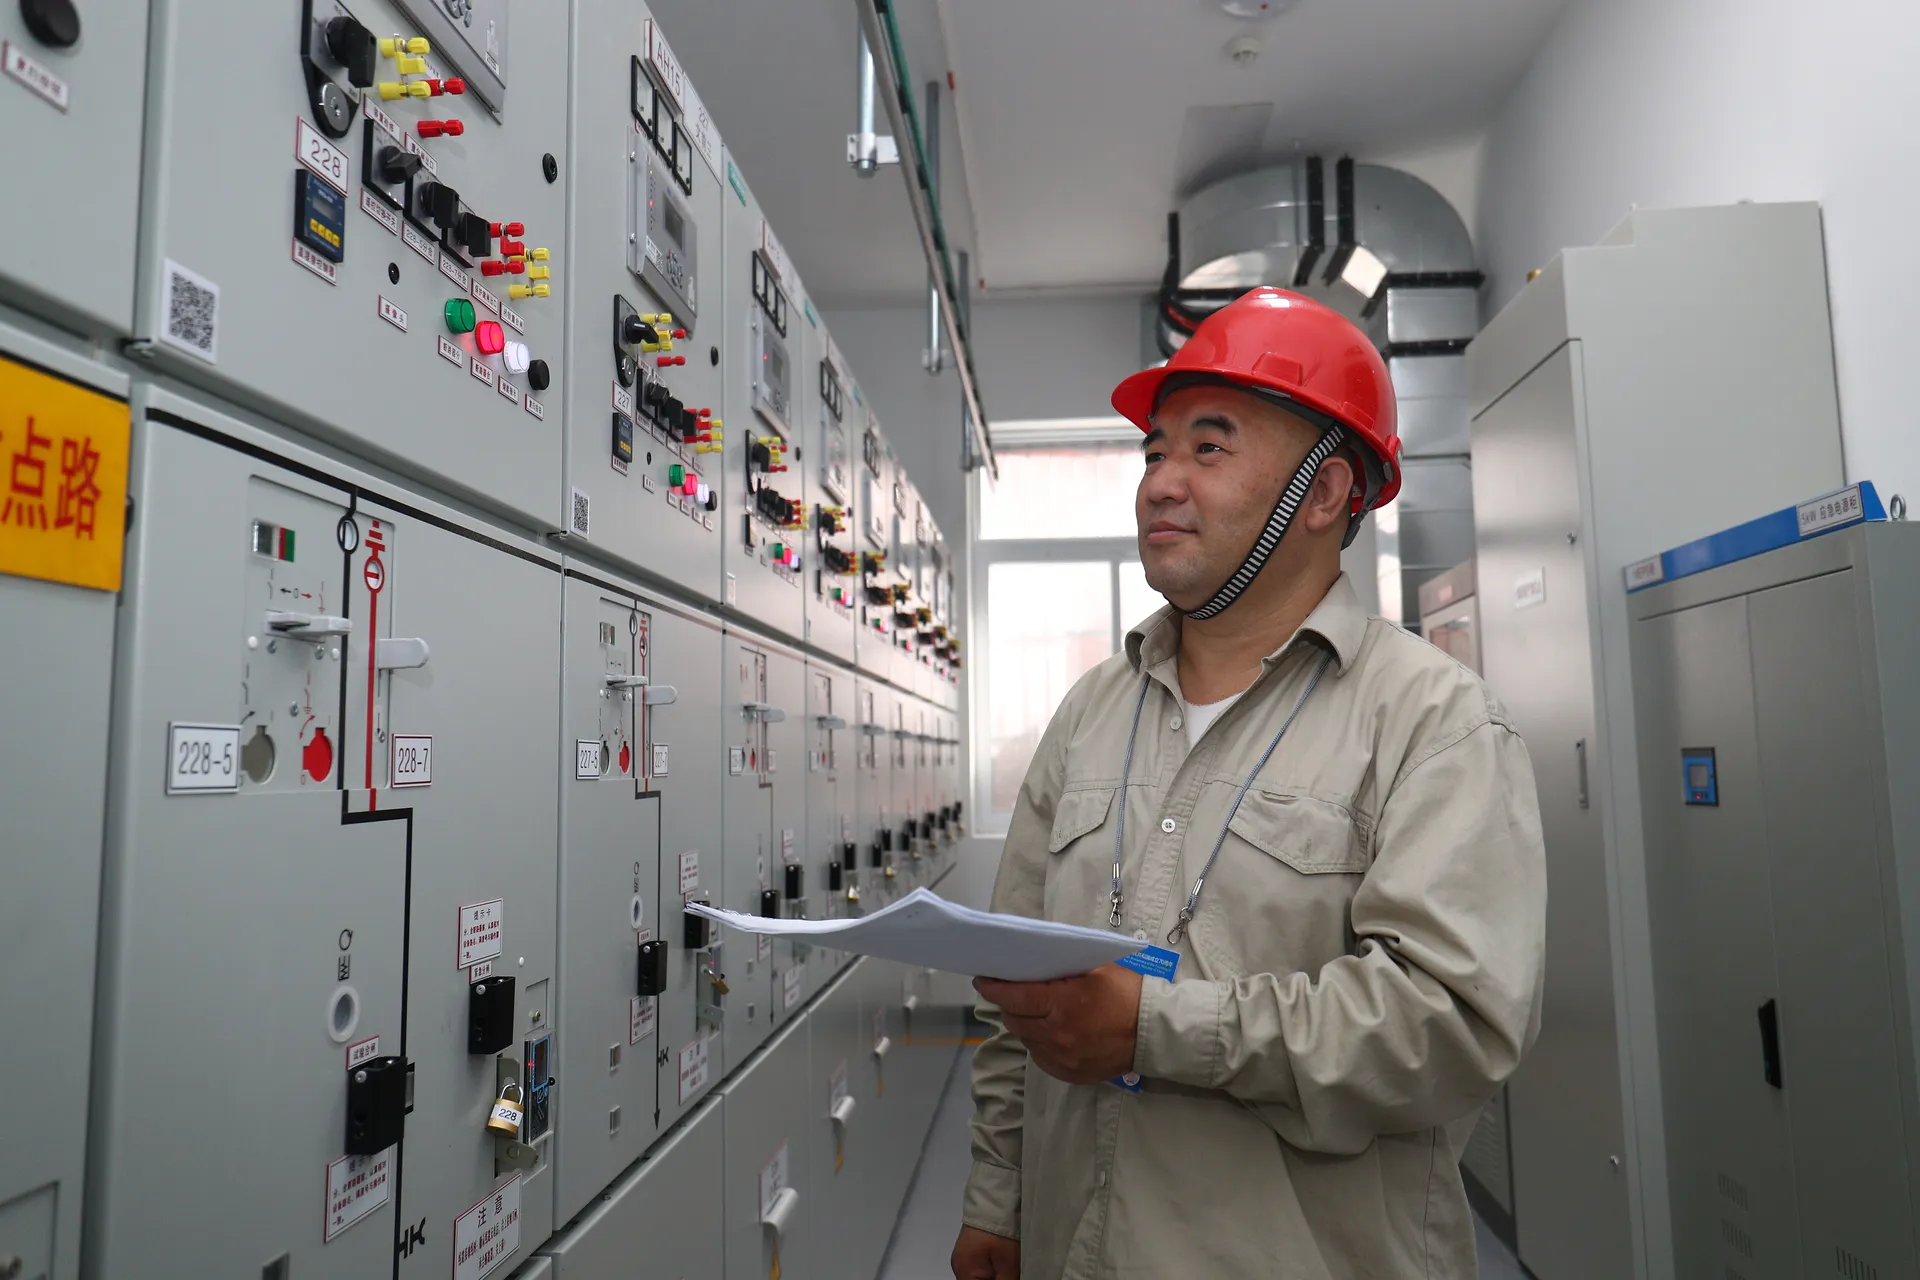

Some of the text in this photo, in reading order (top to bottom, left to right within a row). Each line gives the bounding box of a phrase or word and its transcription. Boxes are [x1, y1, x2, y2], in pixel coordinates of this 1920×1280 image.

[656, 41, 681, 96] AH15
[311, 138, 341, 178] 228
[617, 390, 630, 408] 227
[0, 415, 103, 540] 点路
[178, 738, 234, 778] 228-5
[397, 745, 429, 776] 228-7
[579, 749, 598, 769] 227-5
[498, 1108, 517, 1122] 228
